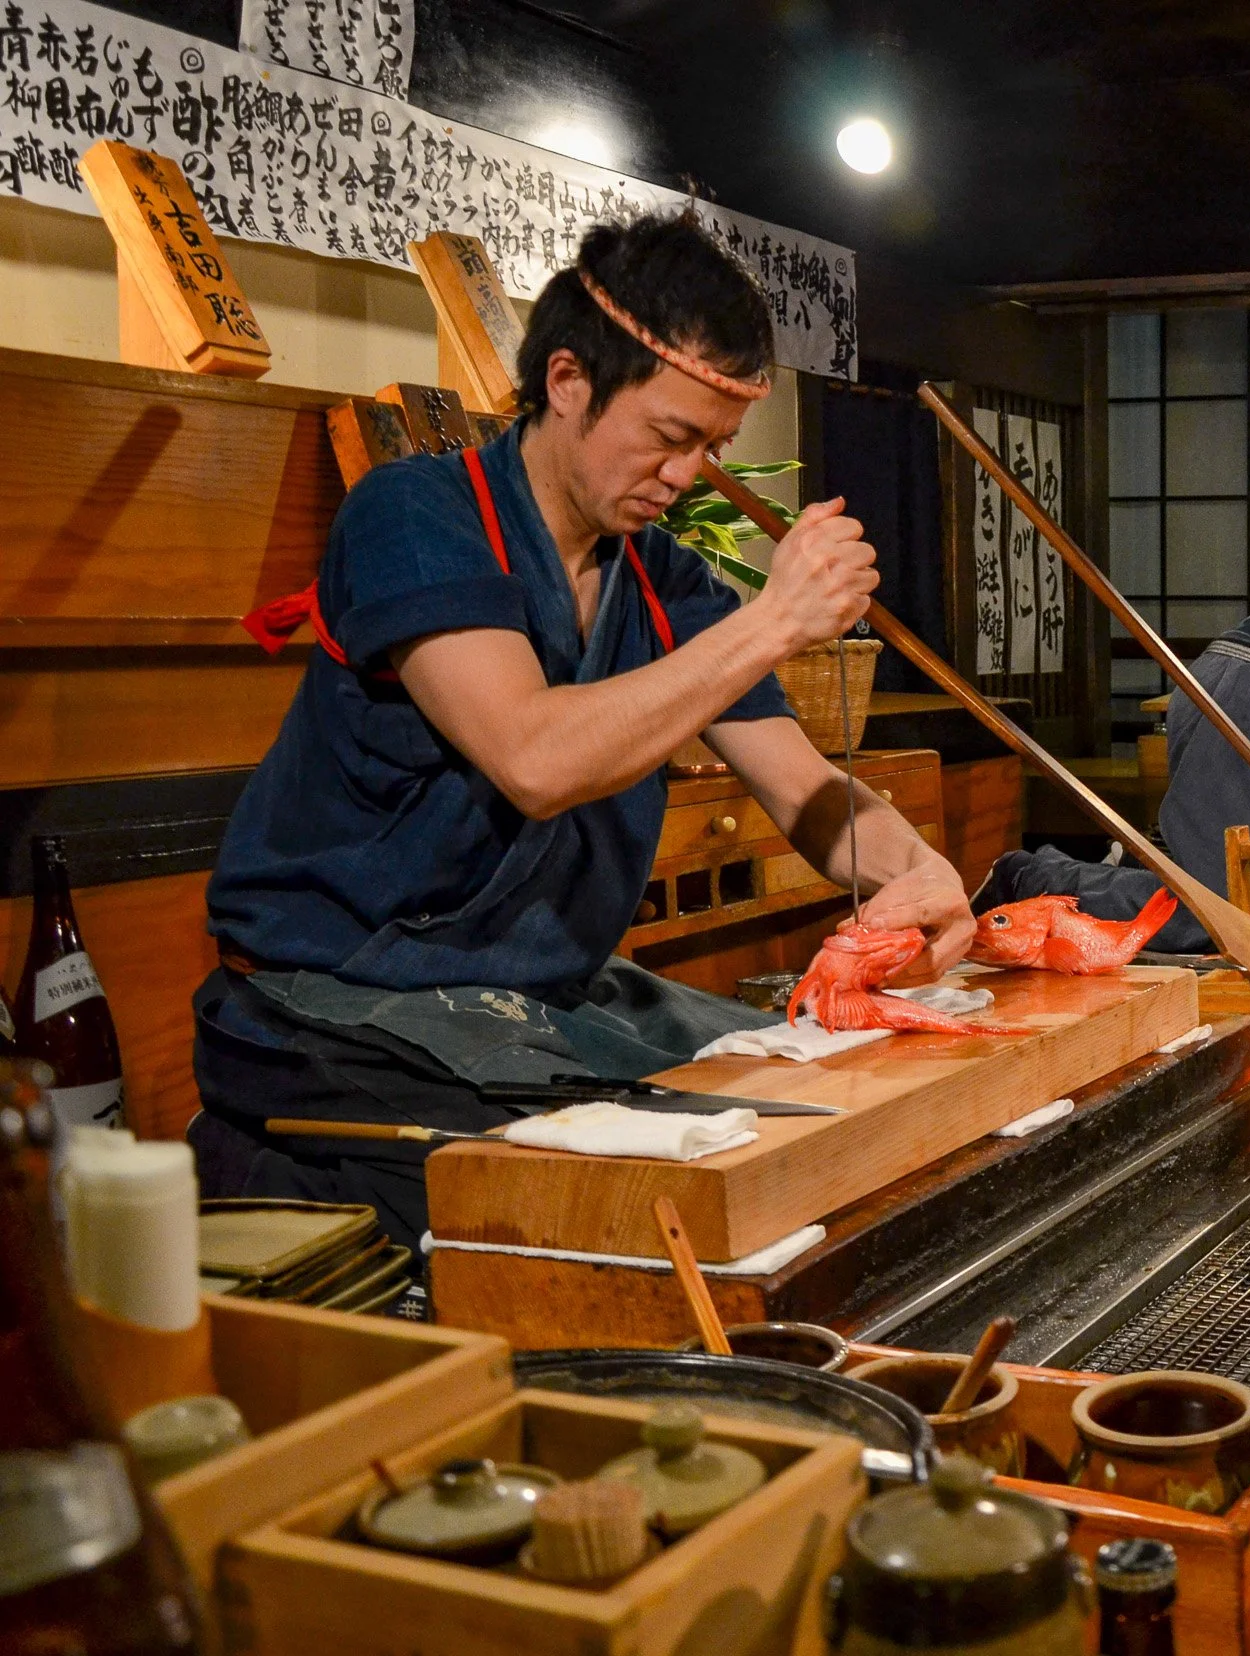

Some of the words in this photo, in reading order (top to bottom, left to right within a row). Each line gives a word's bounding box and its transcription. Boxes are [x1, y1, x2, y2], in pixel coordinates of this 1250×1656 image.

[264, 0, 290, 66] せいろ
[104, 35, 134, 141] じゅん
[132, 47, 169, 148] もず
